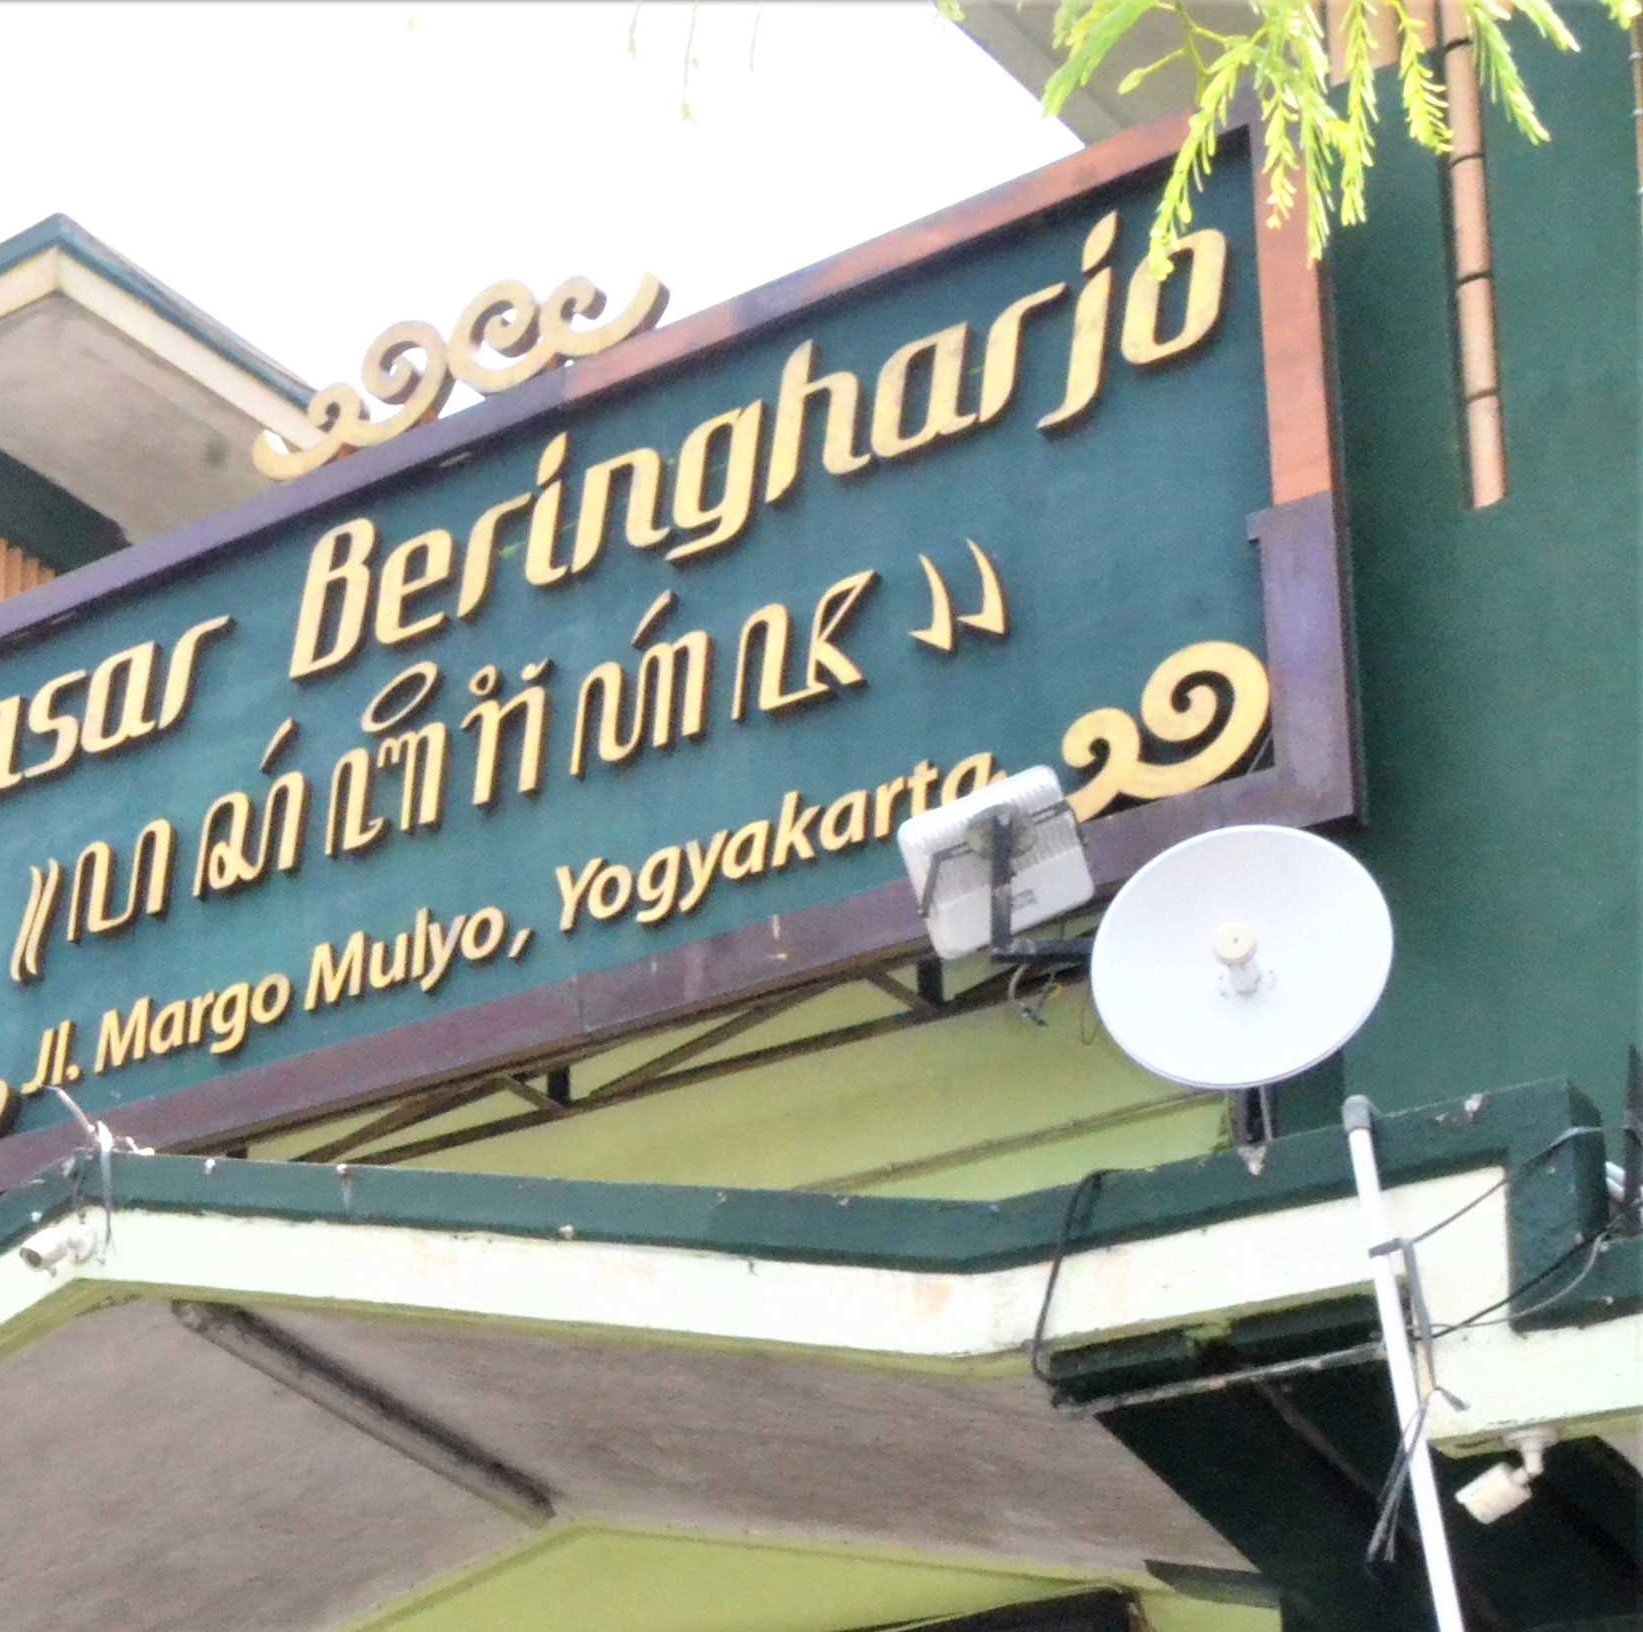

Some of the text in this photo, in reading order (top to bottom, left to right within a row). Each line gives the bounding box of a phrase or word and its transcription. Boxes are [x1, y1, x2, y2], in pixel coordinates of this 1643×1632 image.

[289, 210, 1230, 680] Beringharjo
[21, 750, 1007, 1095] Jl. Margo Mulyo, Yogyakarta
